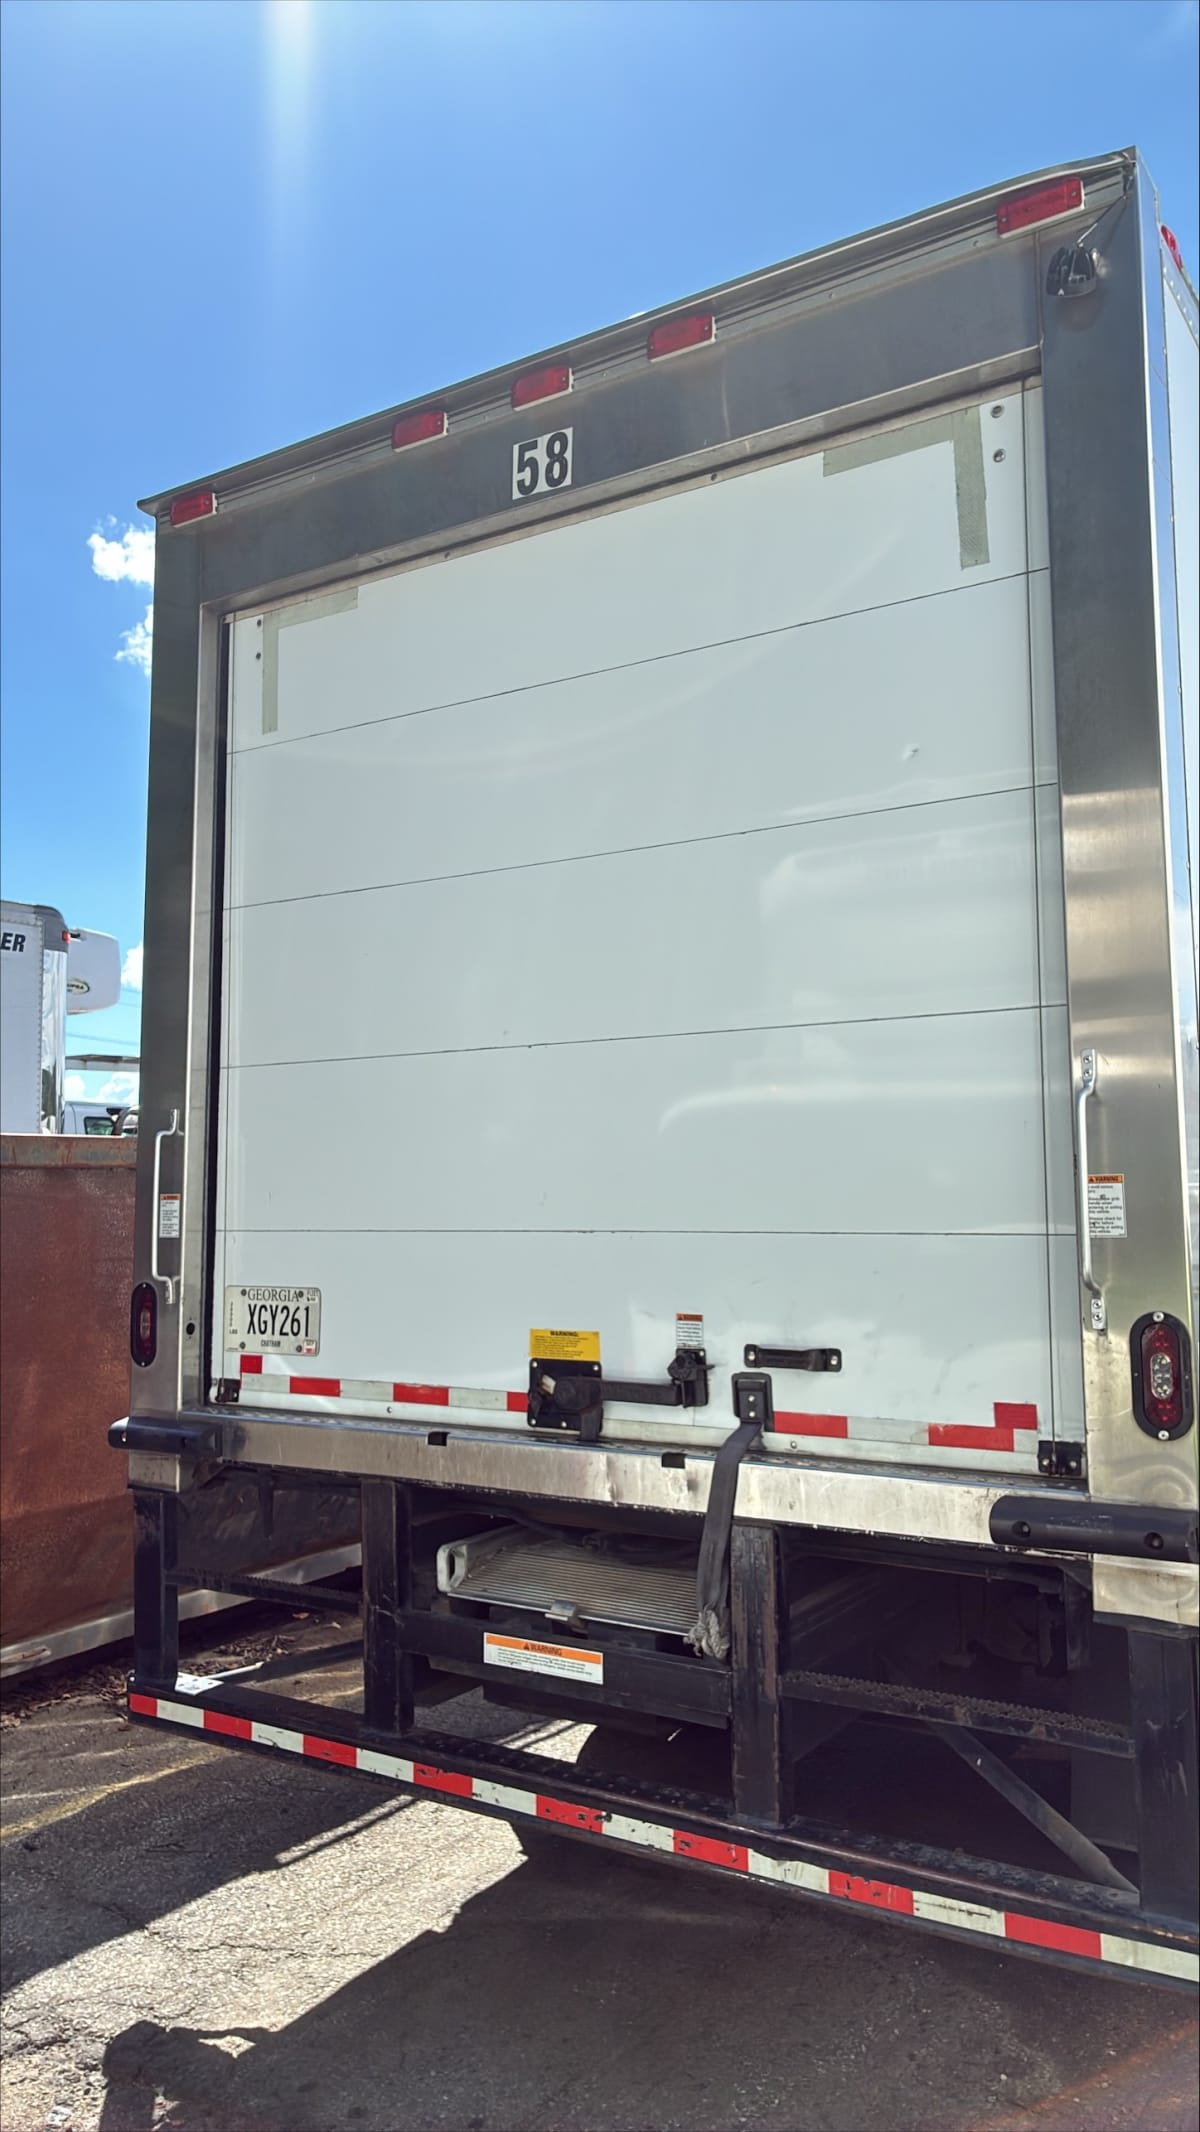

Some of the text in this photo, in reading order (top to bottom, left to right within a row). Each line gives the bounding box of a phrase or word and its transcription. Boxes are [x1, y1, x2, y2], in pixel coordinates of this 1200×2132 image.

[517, 432, 569, 496] 58
[247, 1288, 300, 1302] GEORGIA
[247, 1303, 310, 1337] XGY261
